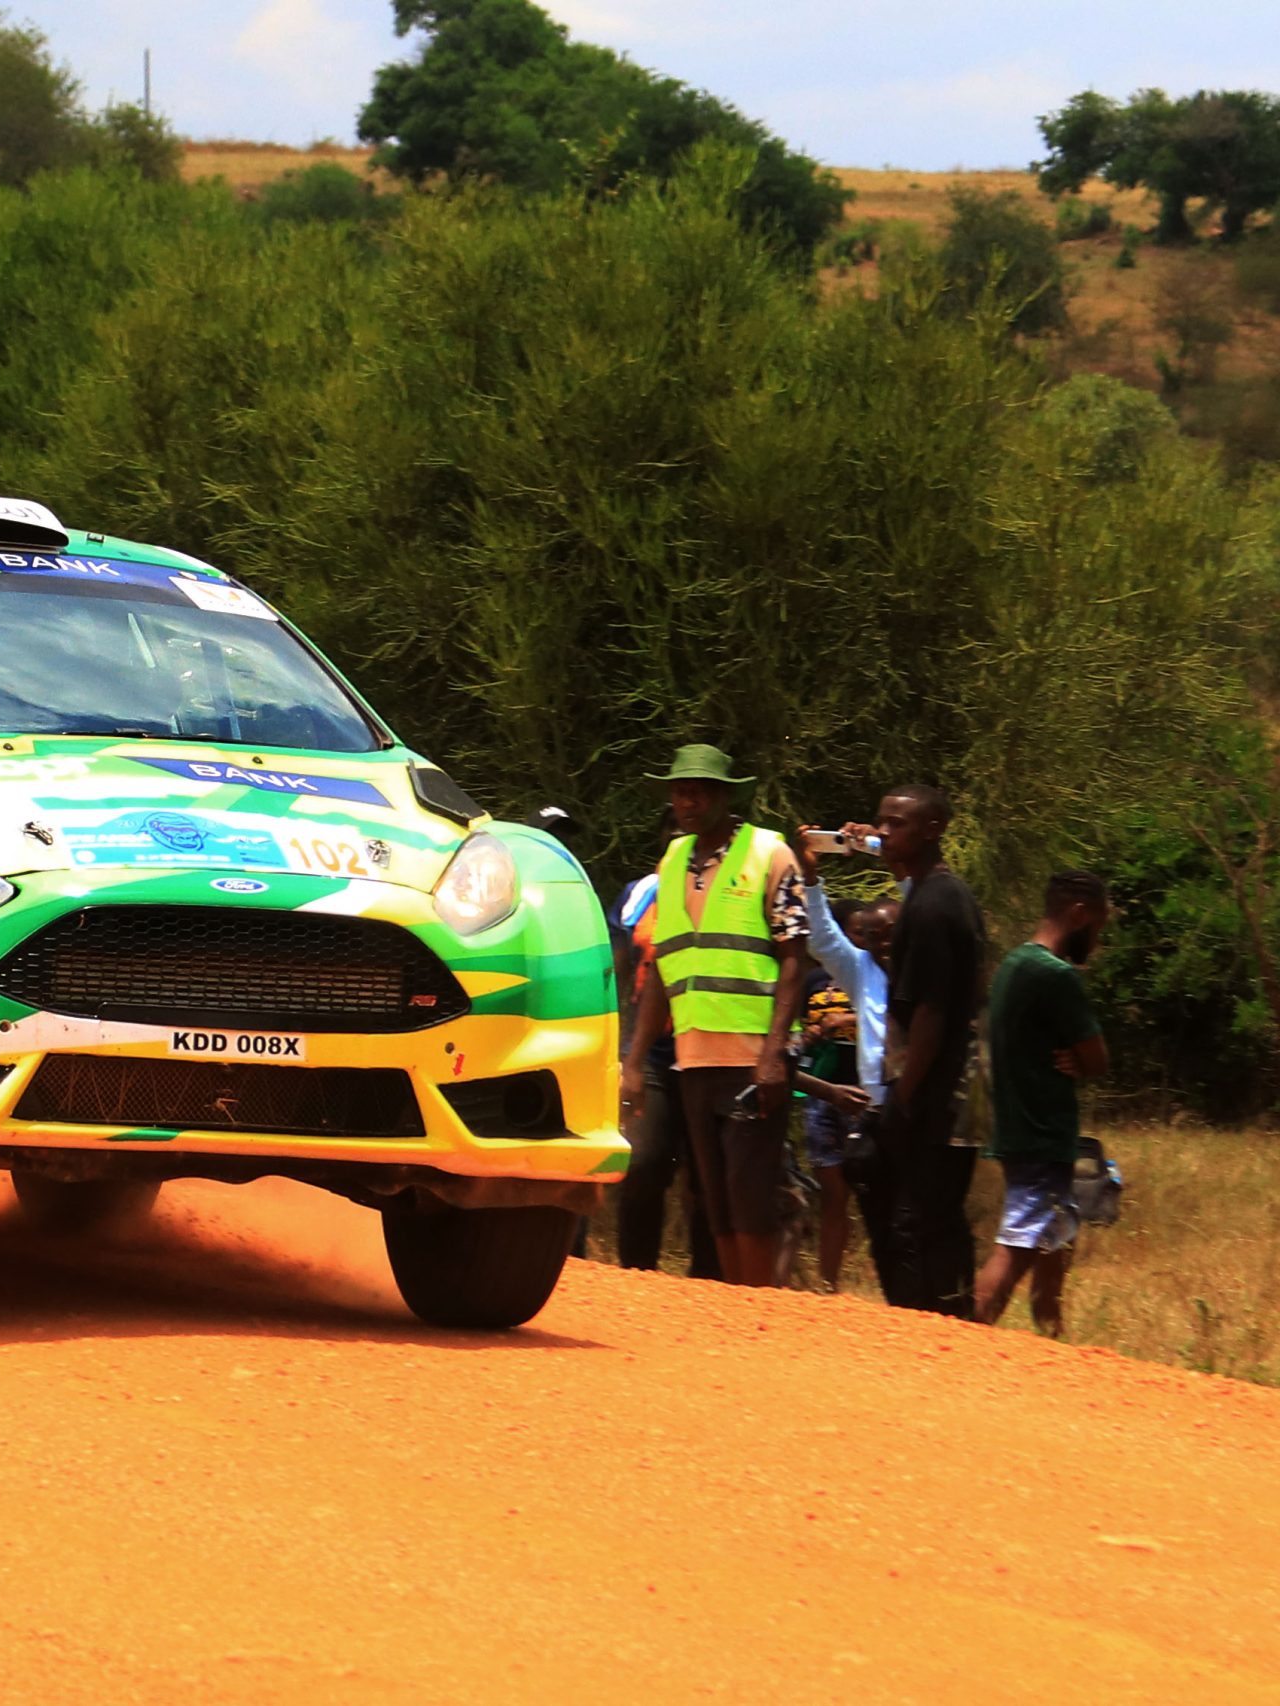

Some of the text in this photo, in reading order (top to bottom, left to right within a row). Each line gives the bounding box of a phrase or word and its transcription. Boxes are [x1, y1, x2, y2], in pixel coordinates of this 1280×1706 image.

[188, 763, 319, 791] BANK
[289, 837, 369, 877] 102
[173, 1031, 300, 1056] KDD 008X
